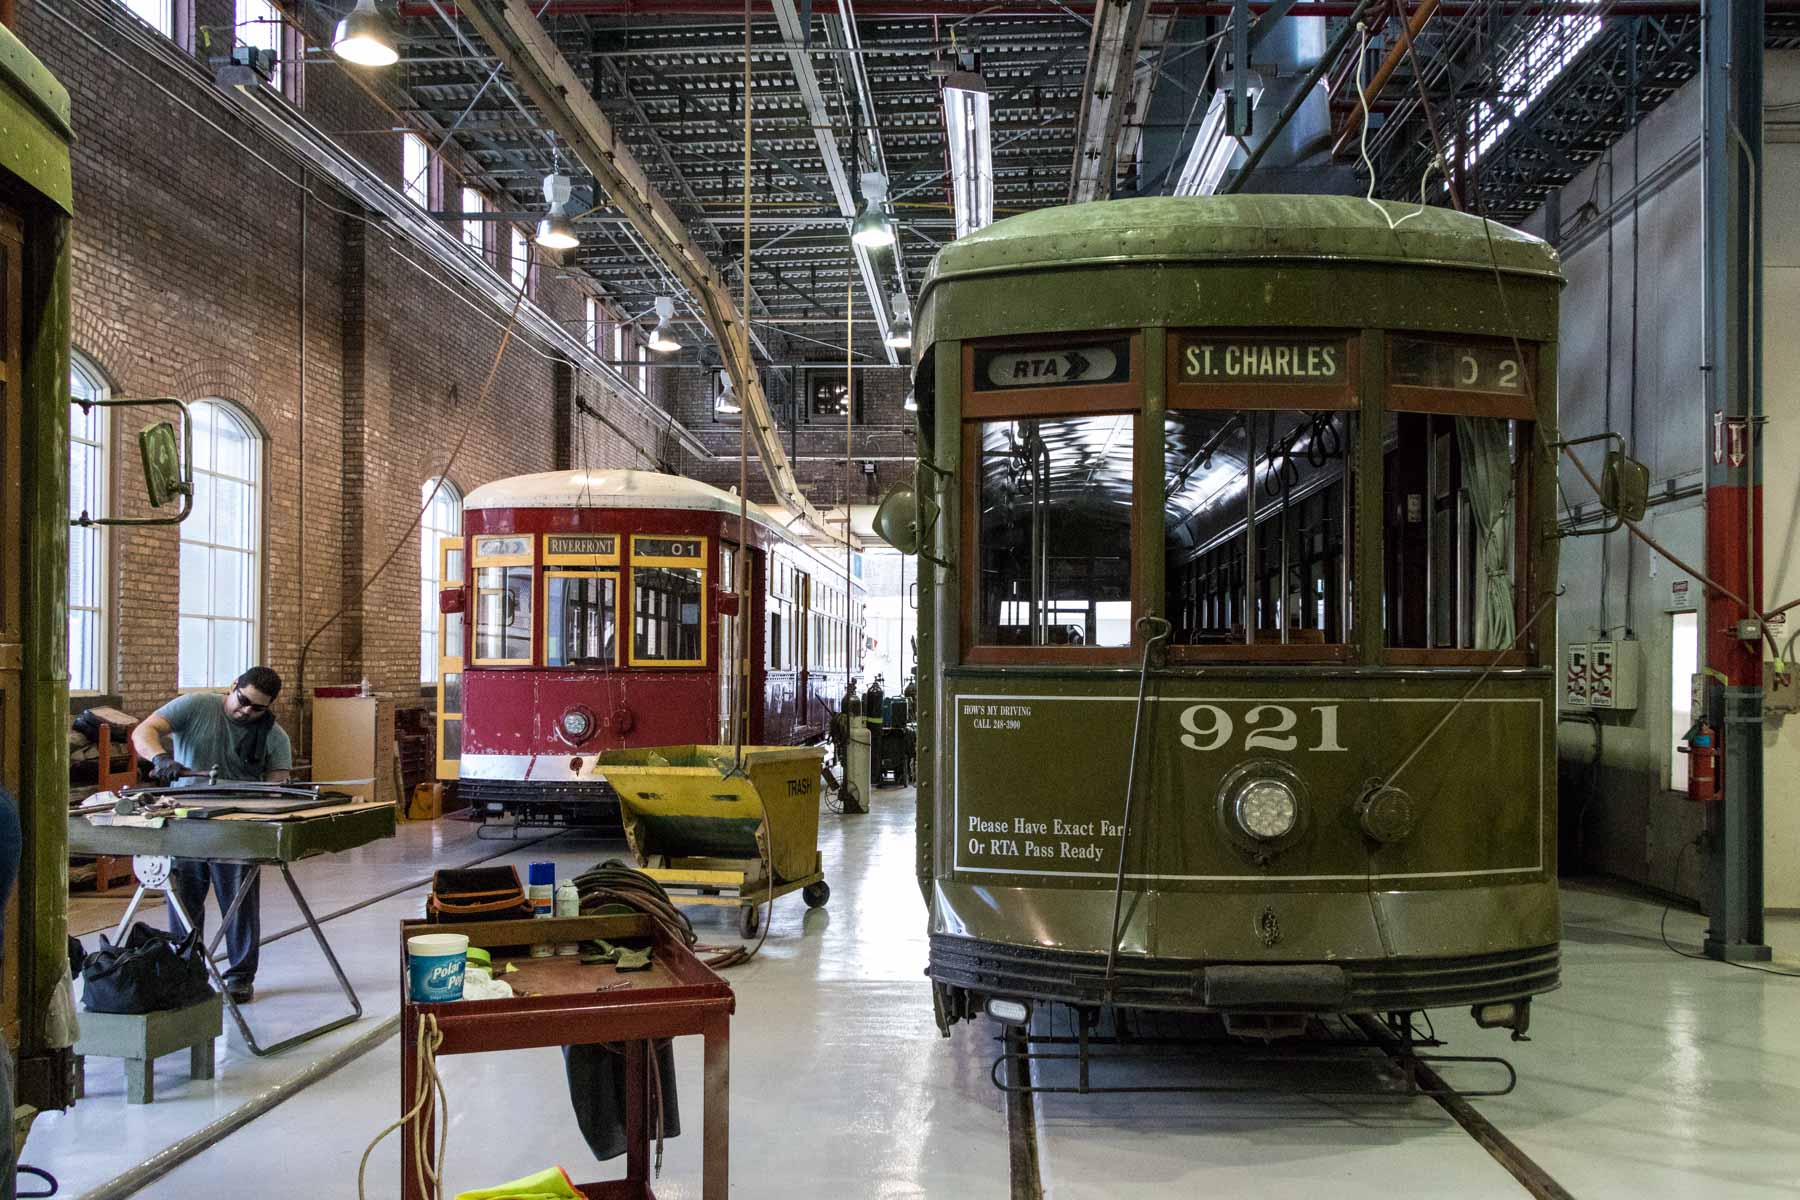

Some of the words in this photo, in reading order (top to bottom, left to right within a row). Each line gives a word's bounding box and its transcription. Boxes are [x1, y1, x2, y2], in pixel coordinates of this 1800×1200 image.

[1012, 358, 1058, 378] RTA
[1186, 346, 1219, 376] ST.
[1225, 346, 1336, 376] CHARLES
[551, 538, 614, 554] RIVERFRONT
[964, 705, 986, 715] HOW'S
[987, 705, 998, 716] MY
[1000, 706, 1032, 717] DRIVING
[973, 719, 992, 729] CALL
[1179, 704, 1348, 751] 921
[787, 777, 813, 797] TRASH
[968, 816, 1009, 832] Please
[1014, 818, 1047, 834] Have
[1053, 819, 1094, 836] Exact
[968, 838, 986, 855] Or
[990, 840, 1020, 856] RTA
[1024, 841, 1054, 857] Pass
[1060, 842, 1104, 862] Ready
[432, 960, 462, 981] Polar
